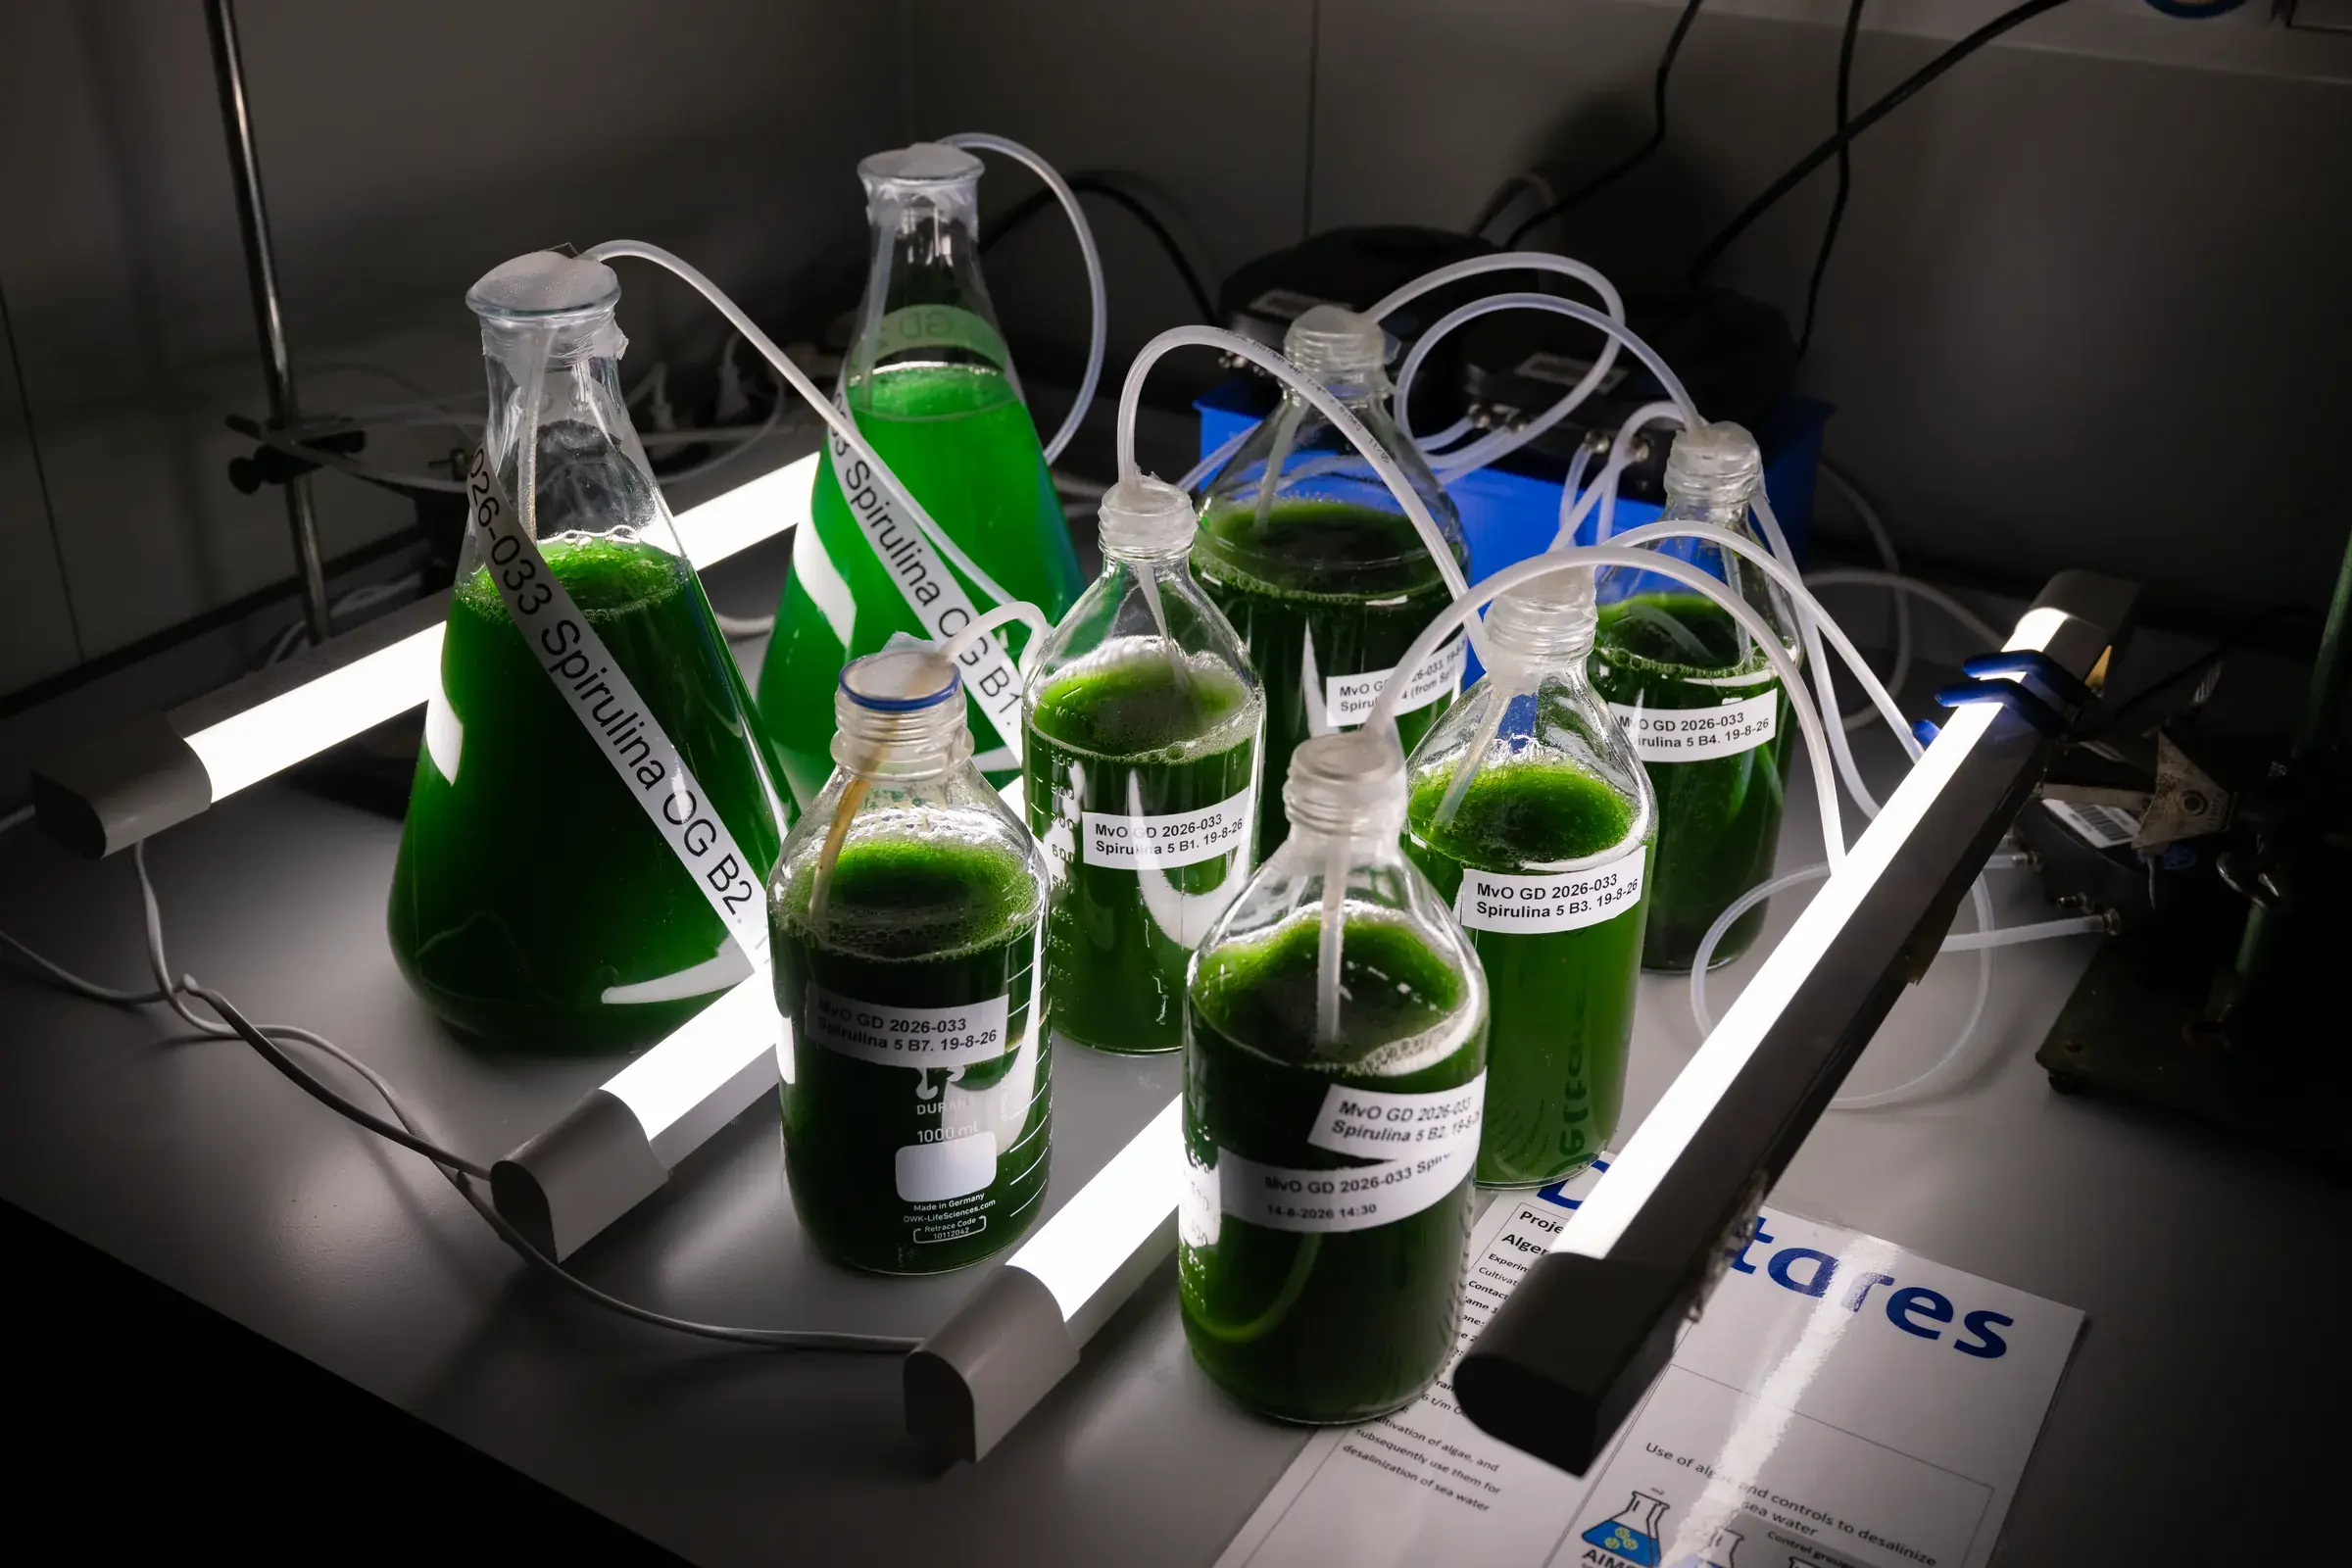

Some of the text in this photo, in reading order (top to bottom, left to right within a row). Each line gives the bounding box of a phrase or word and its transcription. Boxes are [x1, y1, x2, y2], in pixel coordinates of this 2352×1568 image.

[845, 461, 941, 607] Spirulina
[1340, 683, 1370, 697] MvO
[1373, 679, 1389, 692] G
[1653, 719, 1676, 732] GD
[1681, 711, 1744, 732] 2026-033
[1686, 737, 1694, 747] 5
[1698, 736, 1721, 747] B4.
[1725, 717, 1769, 742] 19-8-26
[541, 619, 666, 791] Spirulina
[662, 789, 717, 858] OG
[1095, 813, 1223, 839] MvO GD 2026-033
[1167, 843, 1175, 854] 5
[1179, 839, 1200, 852] B1.
[1203, 817, 1244, 846] 19-8-26
[1052, 844, 1074, 862] 600
[1477, 873, 1618, 900] MvO GD 2026-033
[1477, 878, 1638, 918] Spirulina 5 B3. 19-8-26
[818, 1015, 998, 1052] Spirulina 5 B7. 19-8-26
[857, 1012, 884, 1029] GD
[889, 1017, 967, 1034] 2026-033
[1339, 1101, 1382, 1120] MvO
[1387, 1107, 1413, 1122] GD
[917, 1128, 955, 1144] 1000
[1332, 1119, 1411, 1143] Spirulina
[1415, 1129, 1423, 1142] 5
[1264, 1176, 1301, 1193] MvO
[1307, 1177, 1335, 1194] GD
[1340, 1168, 1412, 1194] 2026-033
[903, 1199, 996, 1223] DWK-LifeSciences.com
[948, 1192, 985, 1208] Germany
[1340, 1203, 1377, 1218] 14:30
[924, 1216, 976, 1233] Retrace Code
[1519, 1210, 1564, 1234] Proje
[1479, 1266, 1519, 1286] Cultivat
[1468, 1280, 1510, 1300] Contact
[1464, 1296, 1489, 1310] ame
[1355, 1428, 1501, 1494] subsequently use them for
[1428, 1437, 1443, 1447] of
[1442, 1443, 1474, 1464] algae,
[1477, 1456, 1499, 1473] and
[1344, 1444, 1491, 1512] desalinization of sea water
[1645, 1442, 1674, 1460] Use
[1677, 1456, 1694, 1472] of
[1739, 1480, 1769, 1499] and
[1771, 1494, 1833, 1526] controls
[1838, 1520, 1854, 1534] to
[1858, 1529, 1937, 1567] desalinize
[1741, 1500, 1819, 1537] sea water
